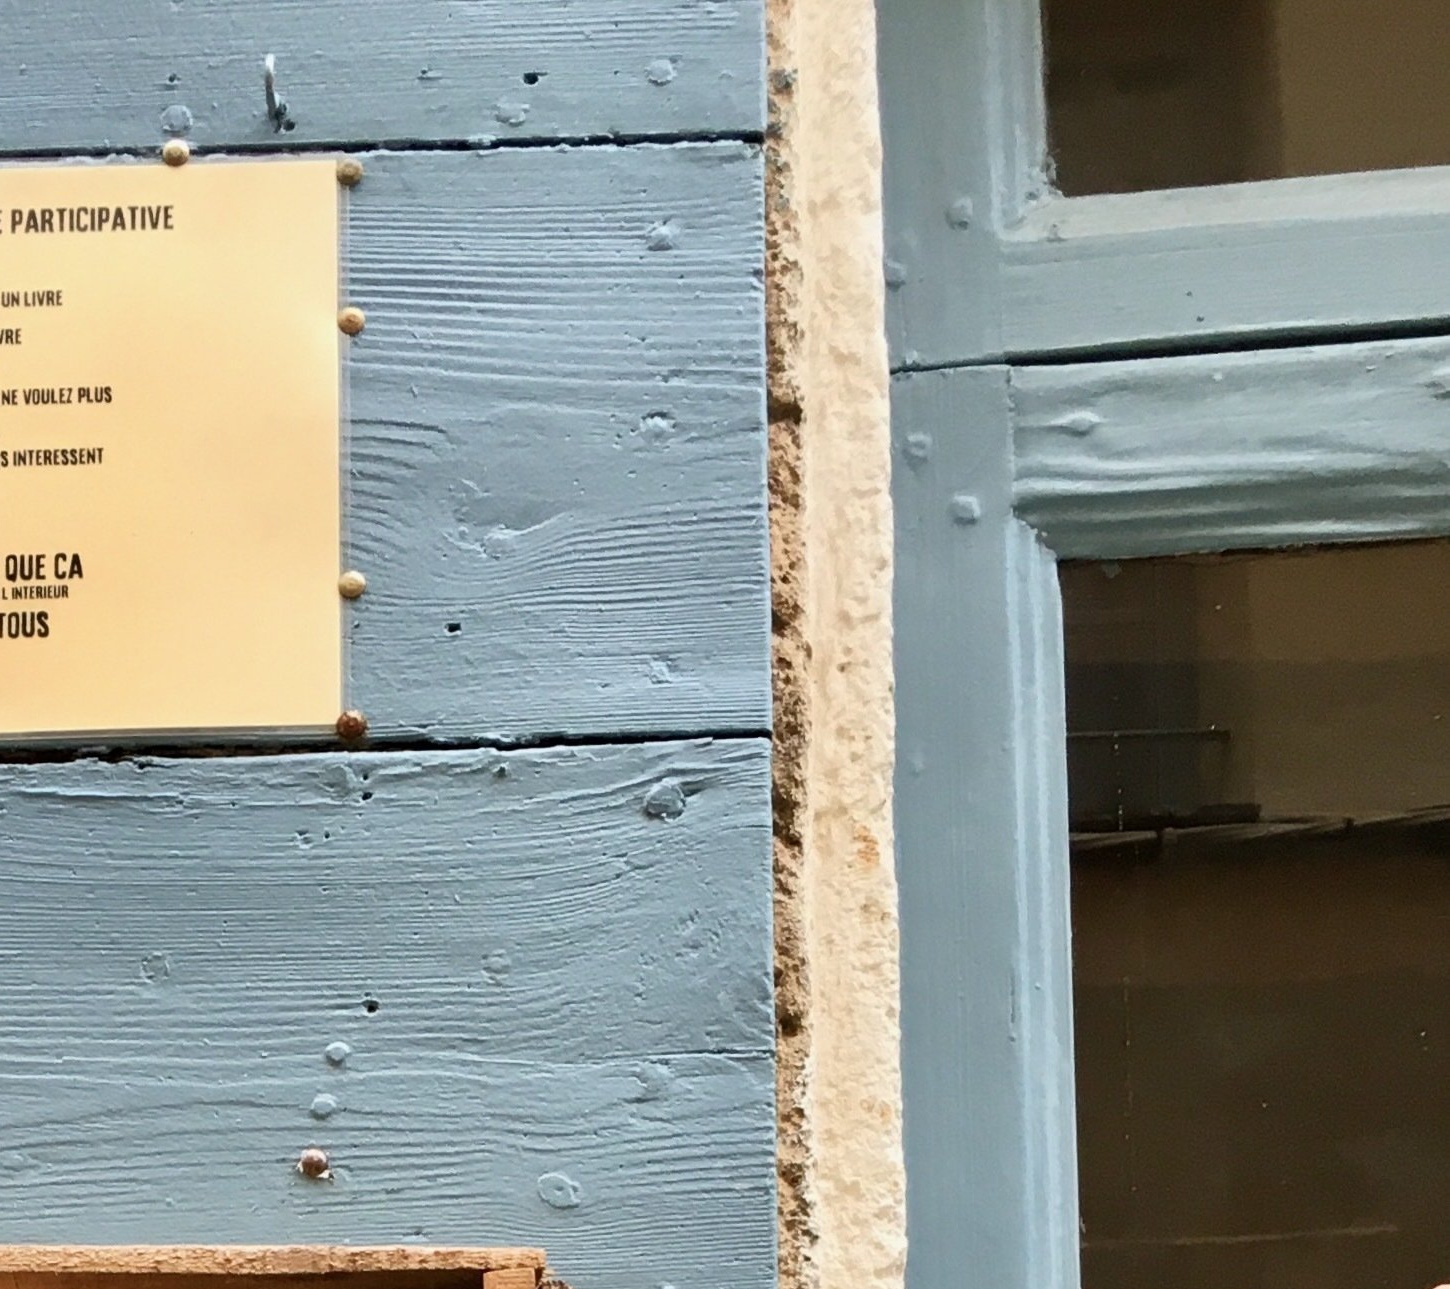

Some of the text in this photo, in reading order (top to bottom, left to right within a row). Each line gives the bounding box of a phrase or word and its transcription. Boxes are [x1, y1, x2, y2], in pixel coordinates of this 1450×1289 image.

[10, 205, 174, 235] PARTICIPATIVE
[1, 291, 19, 308] UN
[24, 290, 63, 307] LIVRE
[2, 389, 18, 406] NE
[23, 387, 72, 405] VOULEZ
[78, 386, 112, 404] PLUS
[13, 447, 103, 467] INTERESSENT
[6, 554, 46, 583] QUE
[54, 552, 83, 580] CA
[12, 585, 68, 600] INTERIEUR
